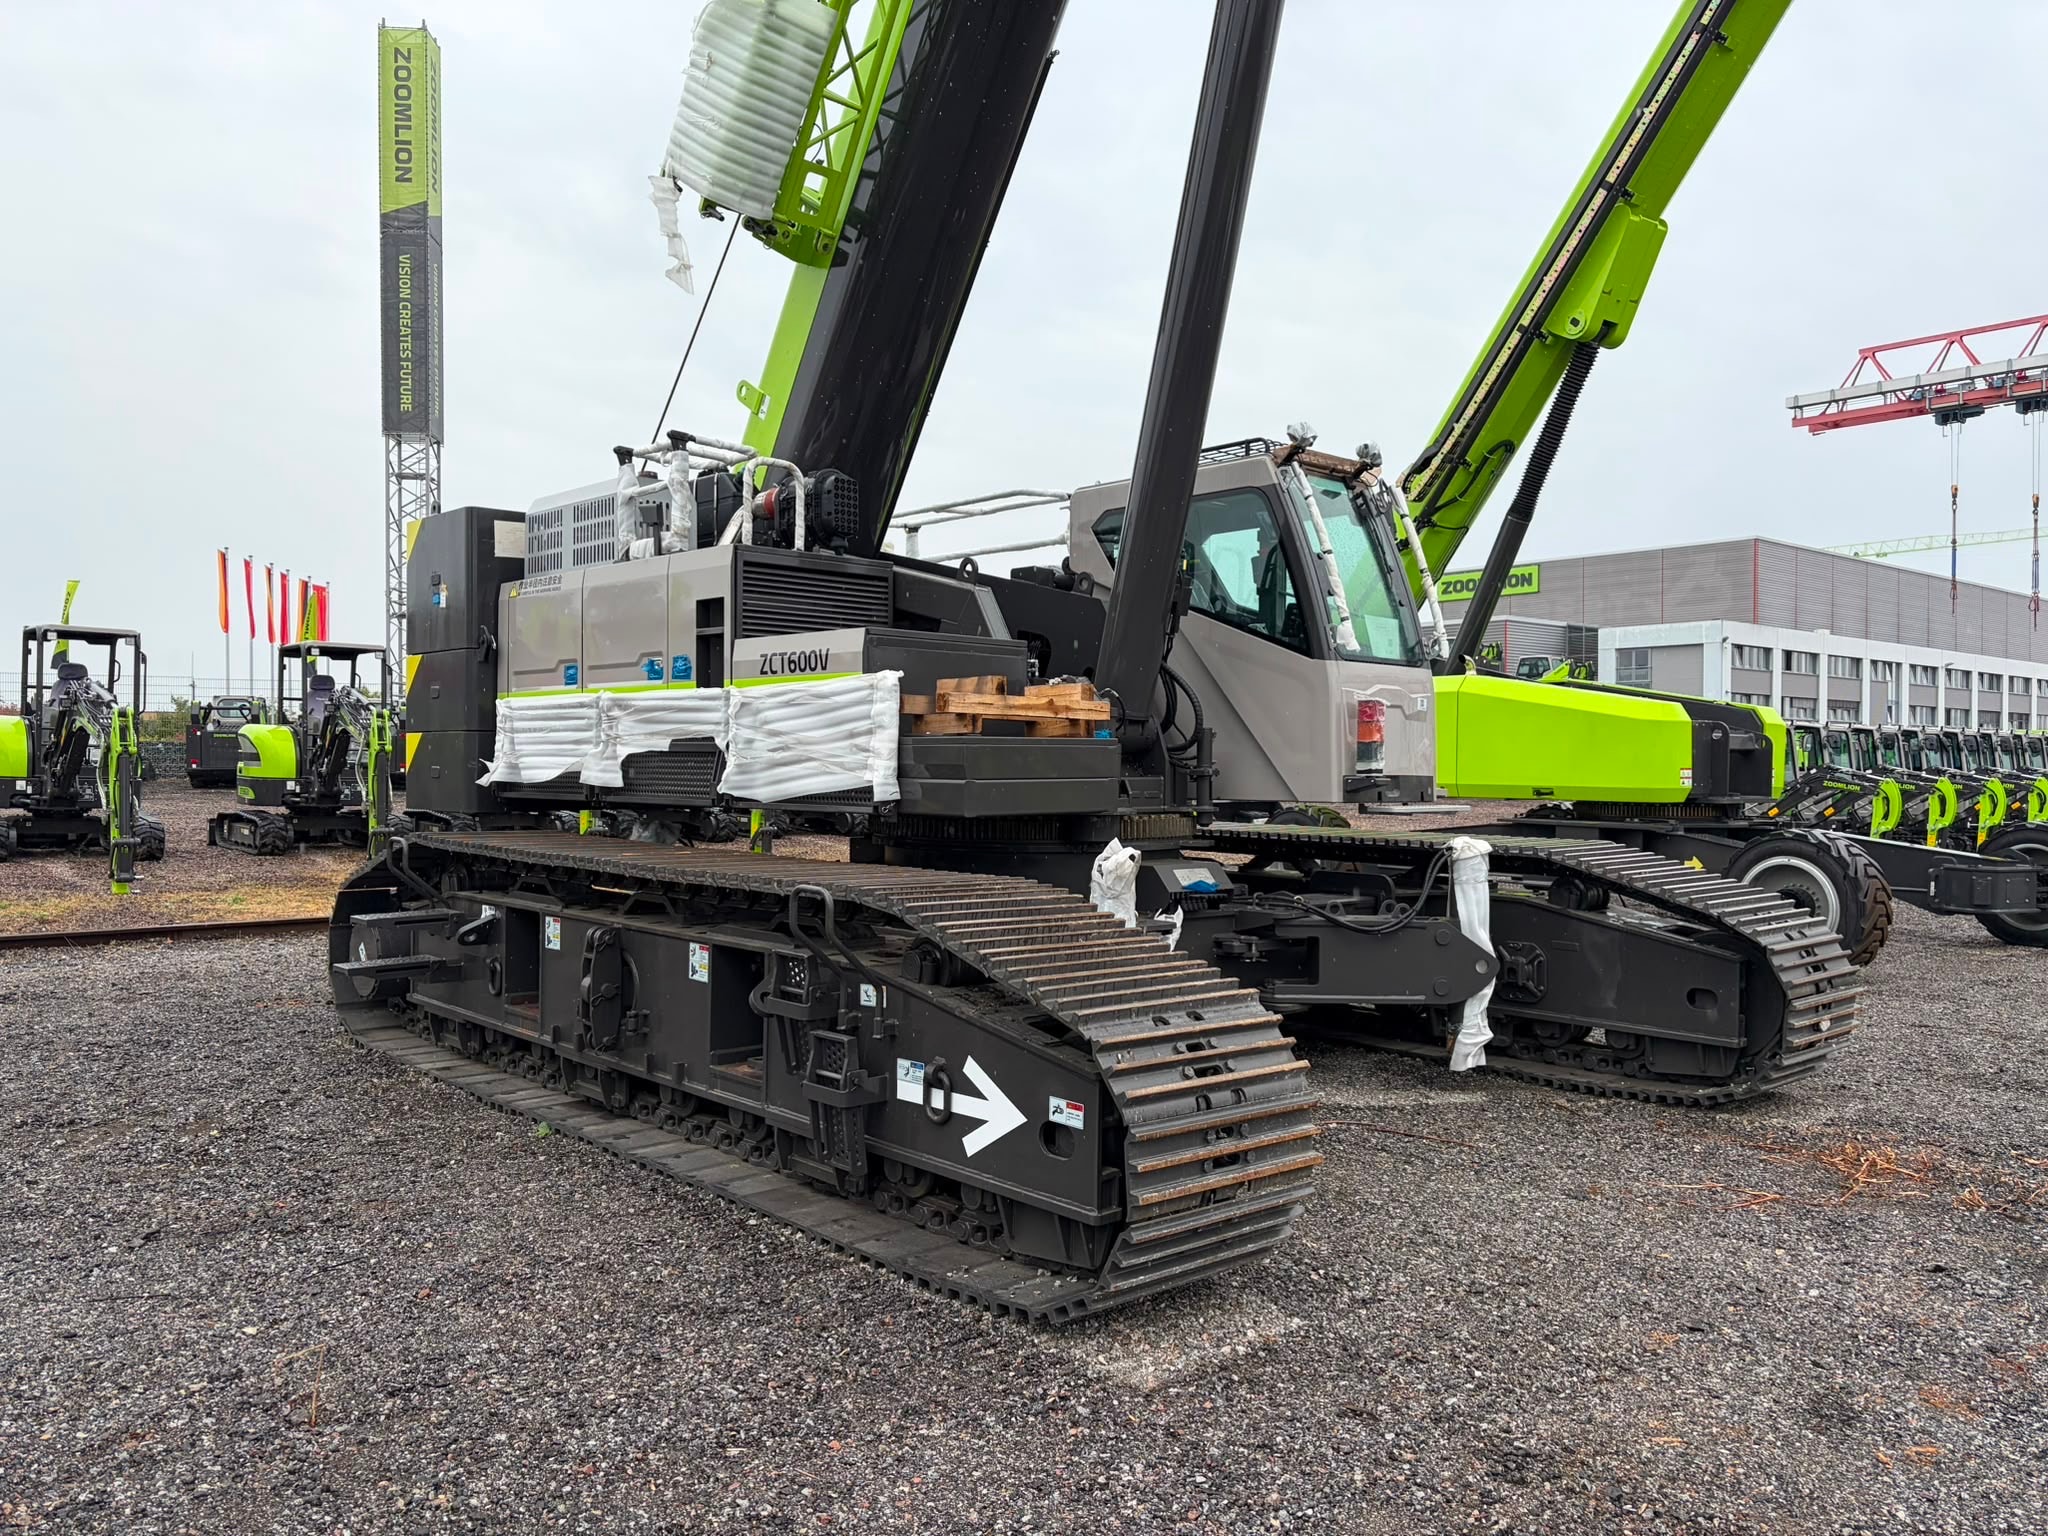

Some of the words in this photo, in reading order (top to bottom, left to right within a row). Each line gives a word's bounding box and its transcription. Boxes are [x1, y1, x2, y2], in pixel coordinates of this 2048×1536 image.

[394, 47, 412, 183] ZOOMLION
[430, 56, 438, 194] ZOOMLION
[399, 254, 411, 299] VISION
[399, 302, 412, 359] CREATES
[400, 361, 412, 412] FUTURE
[1441, 572, 1533, 595] ZOOON
[760, 648, 830, 675] ZCT600V
[1823, 780, 1861, 791] ZOOMLION
